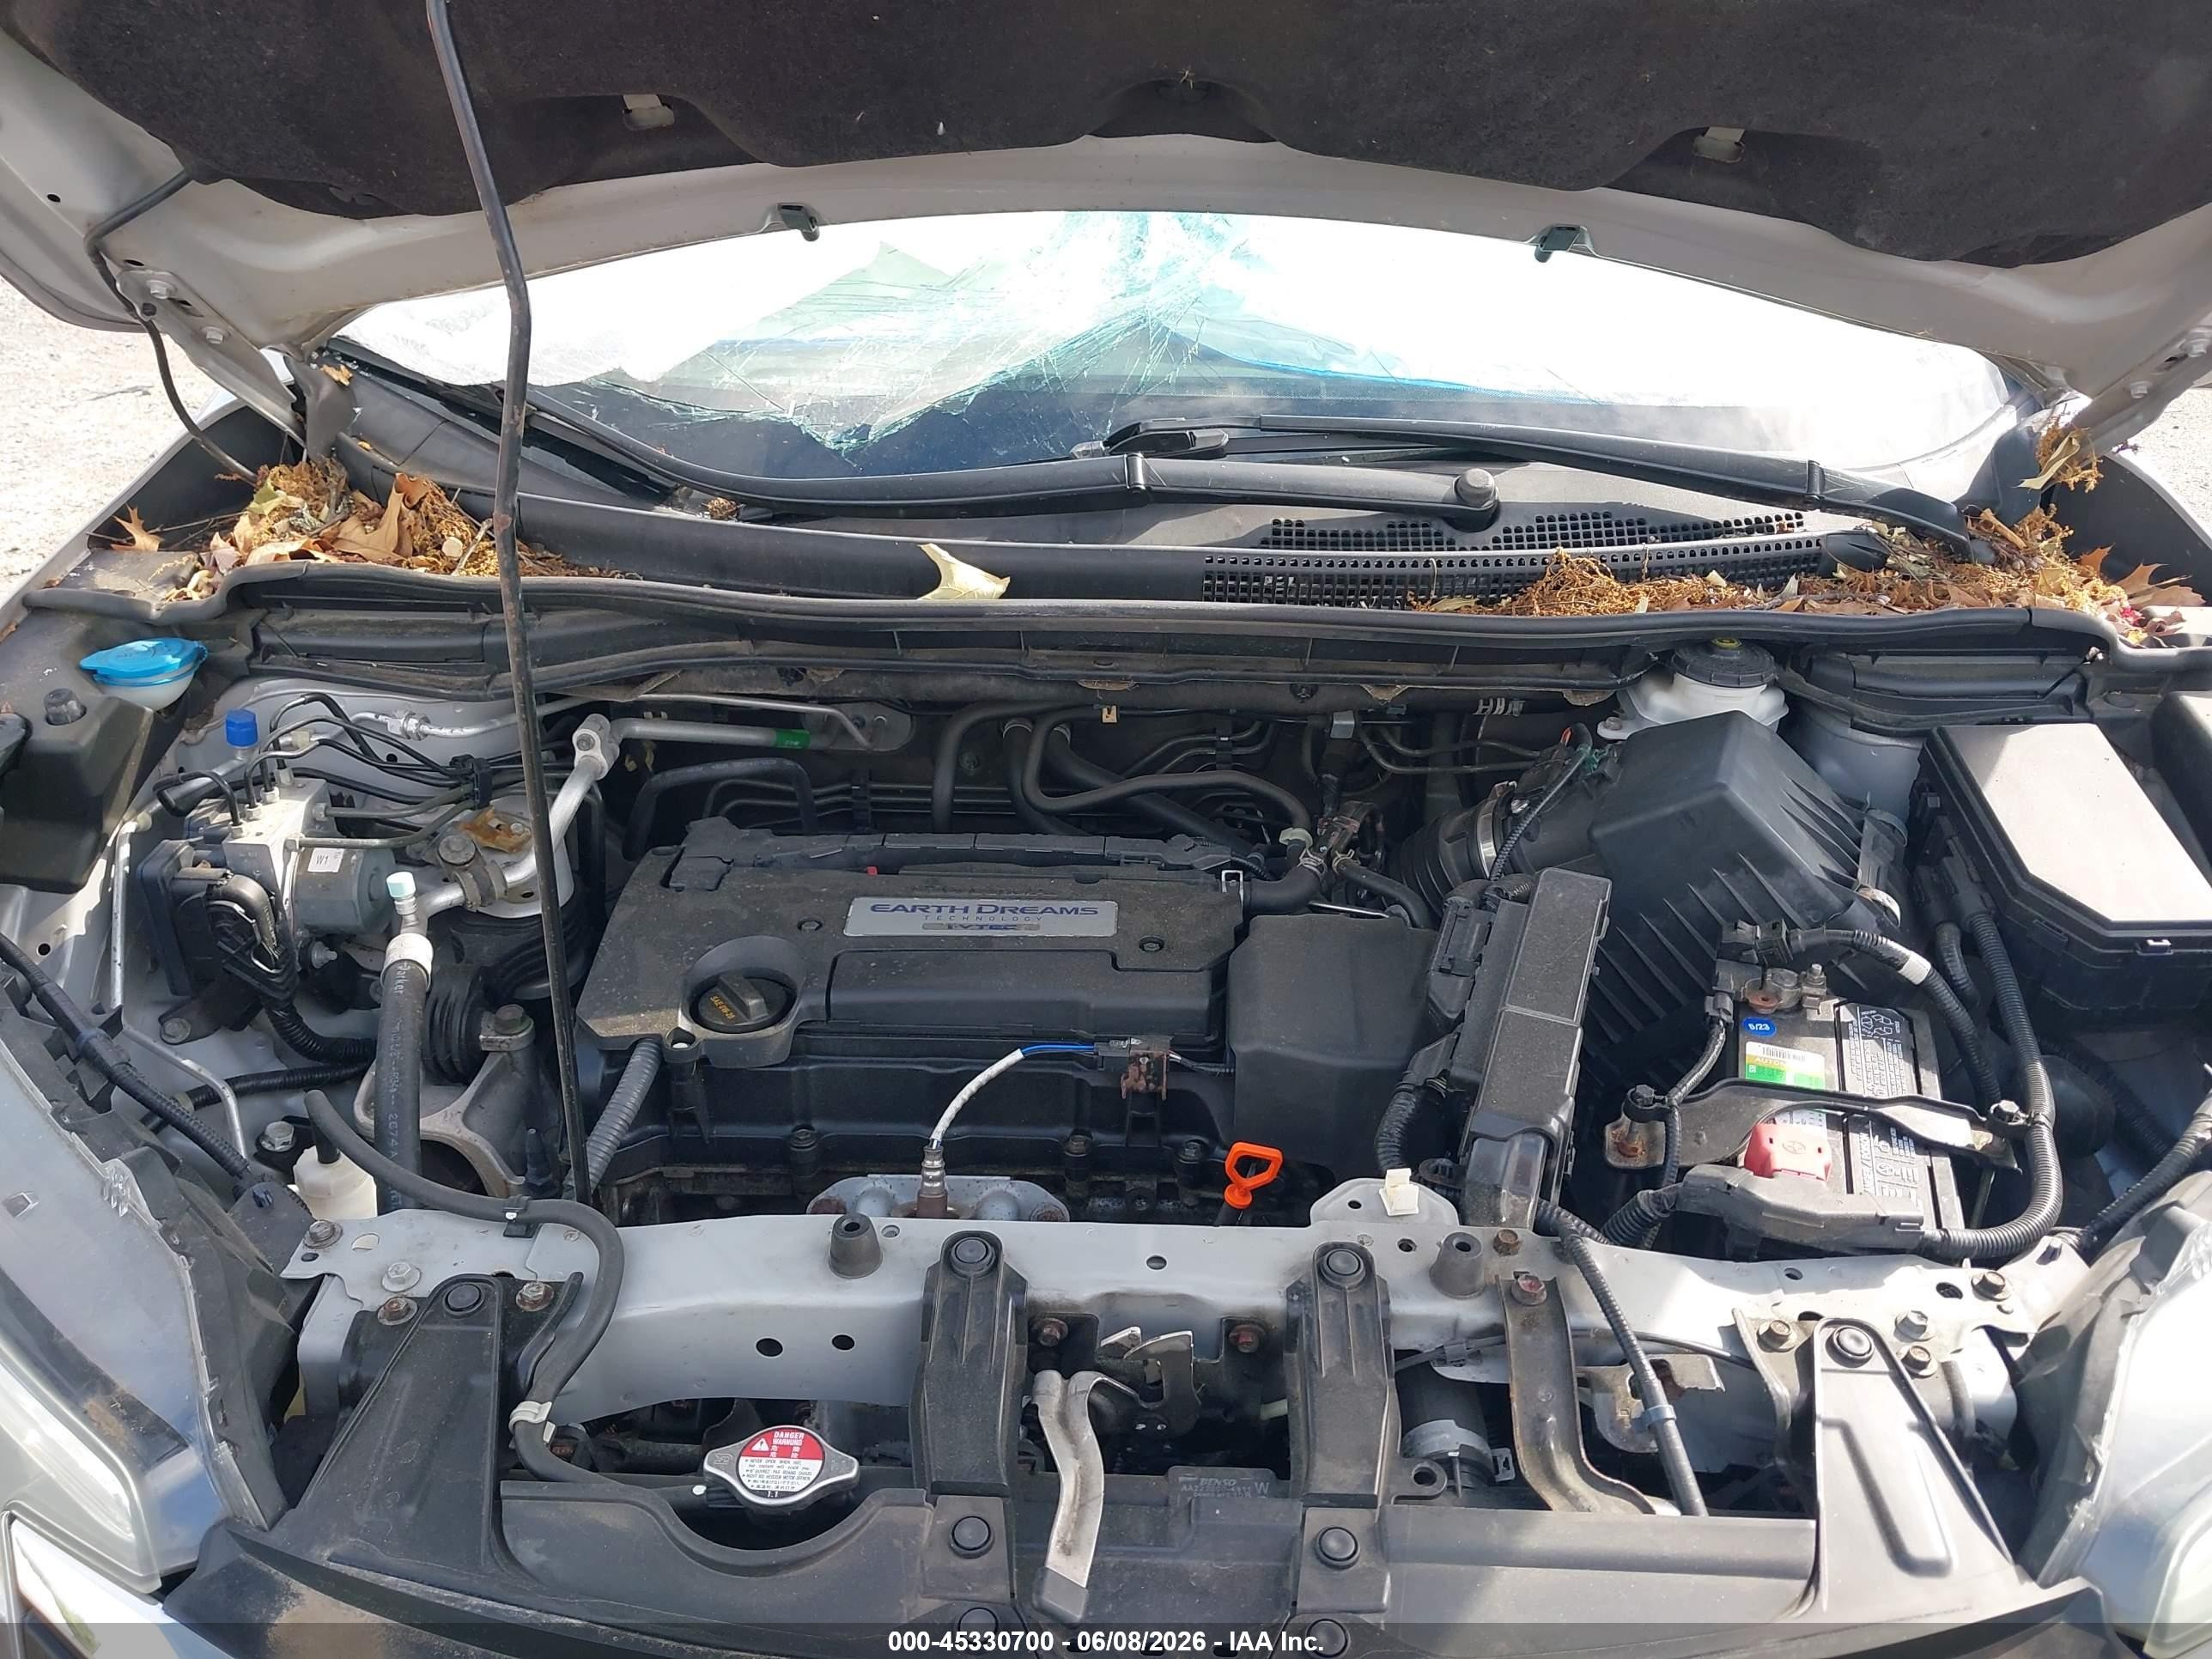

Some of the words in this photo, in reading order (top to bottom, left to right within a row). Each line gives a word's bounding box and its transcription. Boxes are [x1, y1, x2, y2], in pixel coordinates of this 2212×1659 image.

[316, 854, 329, 866] W1
[870, 902, 969, 915] EARTH
[975, 903, 1099, 915] DREAMS
